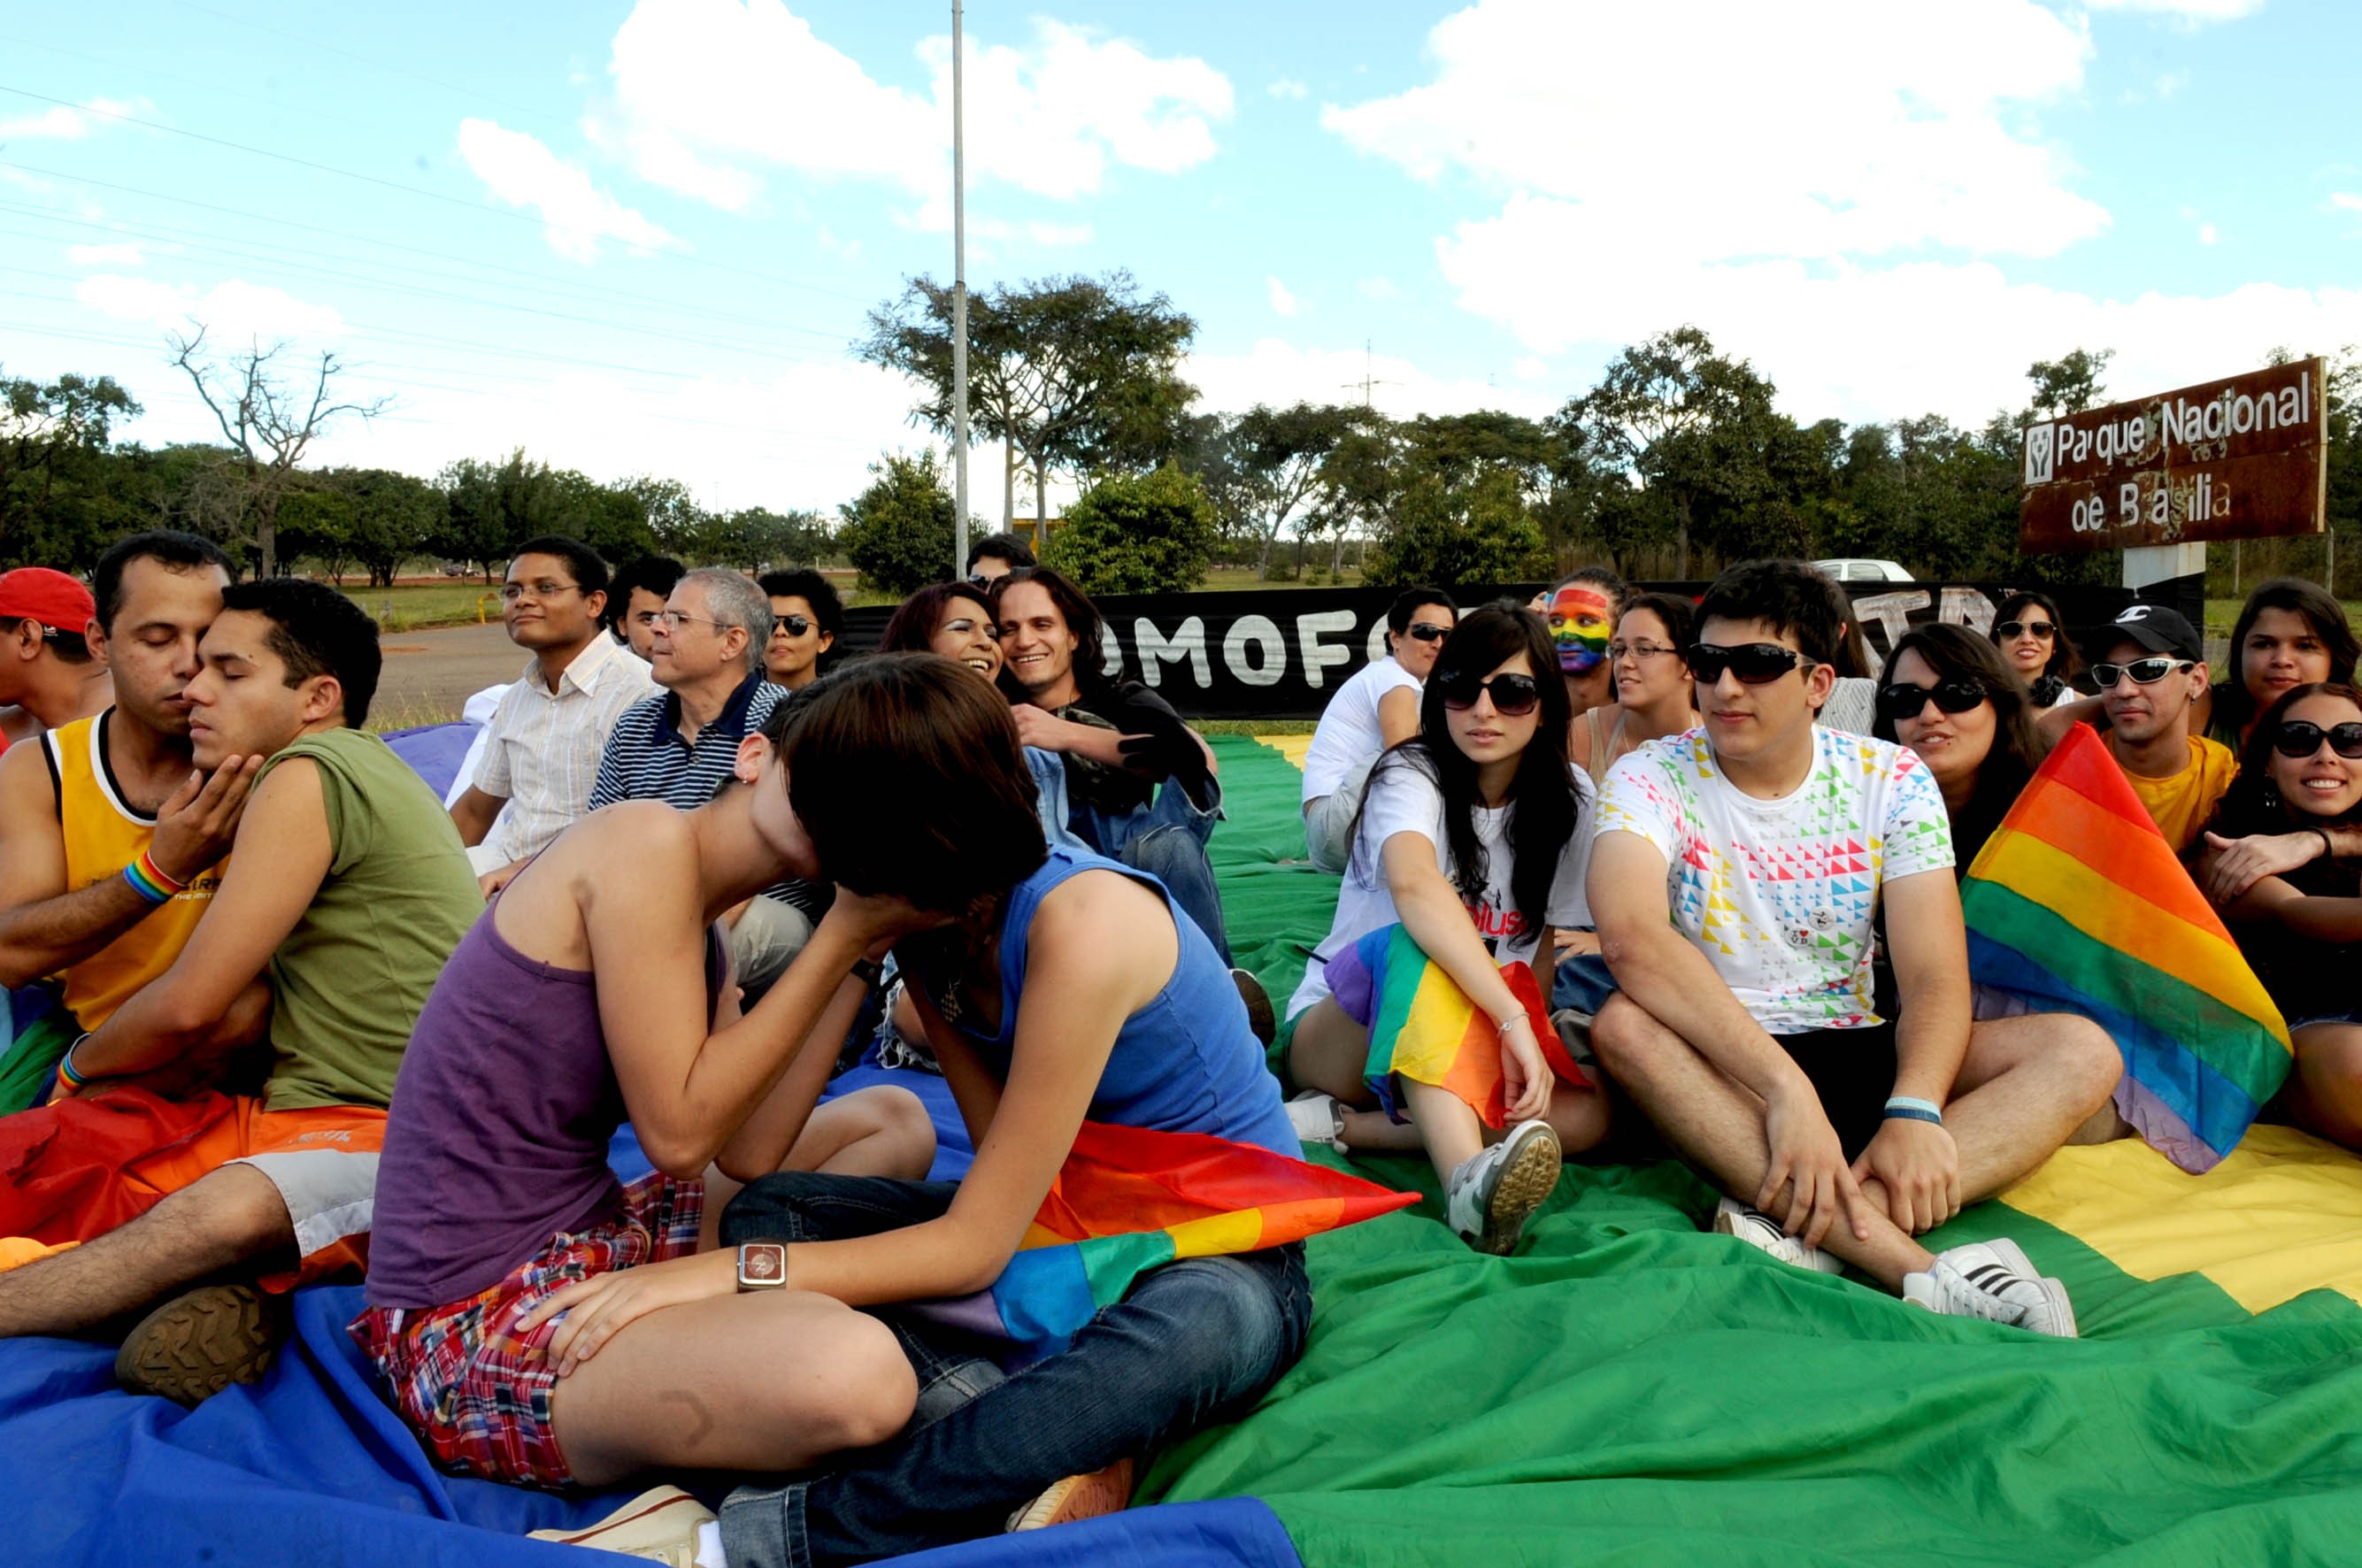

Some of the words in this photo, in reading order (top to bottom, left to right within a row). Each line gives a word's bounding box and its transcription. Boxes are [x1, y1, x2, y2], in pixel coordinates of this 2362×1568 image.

[2057, 416, 2145, 466] Parque
[2162, 371, 2309, 446] Nacional
[1101, 610, 1388, 688] MOF
